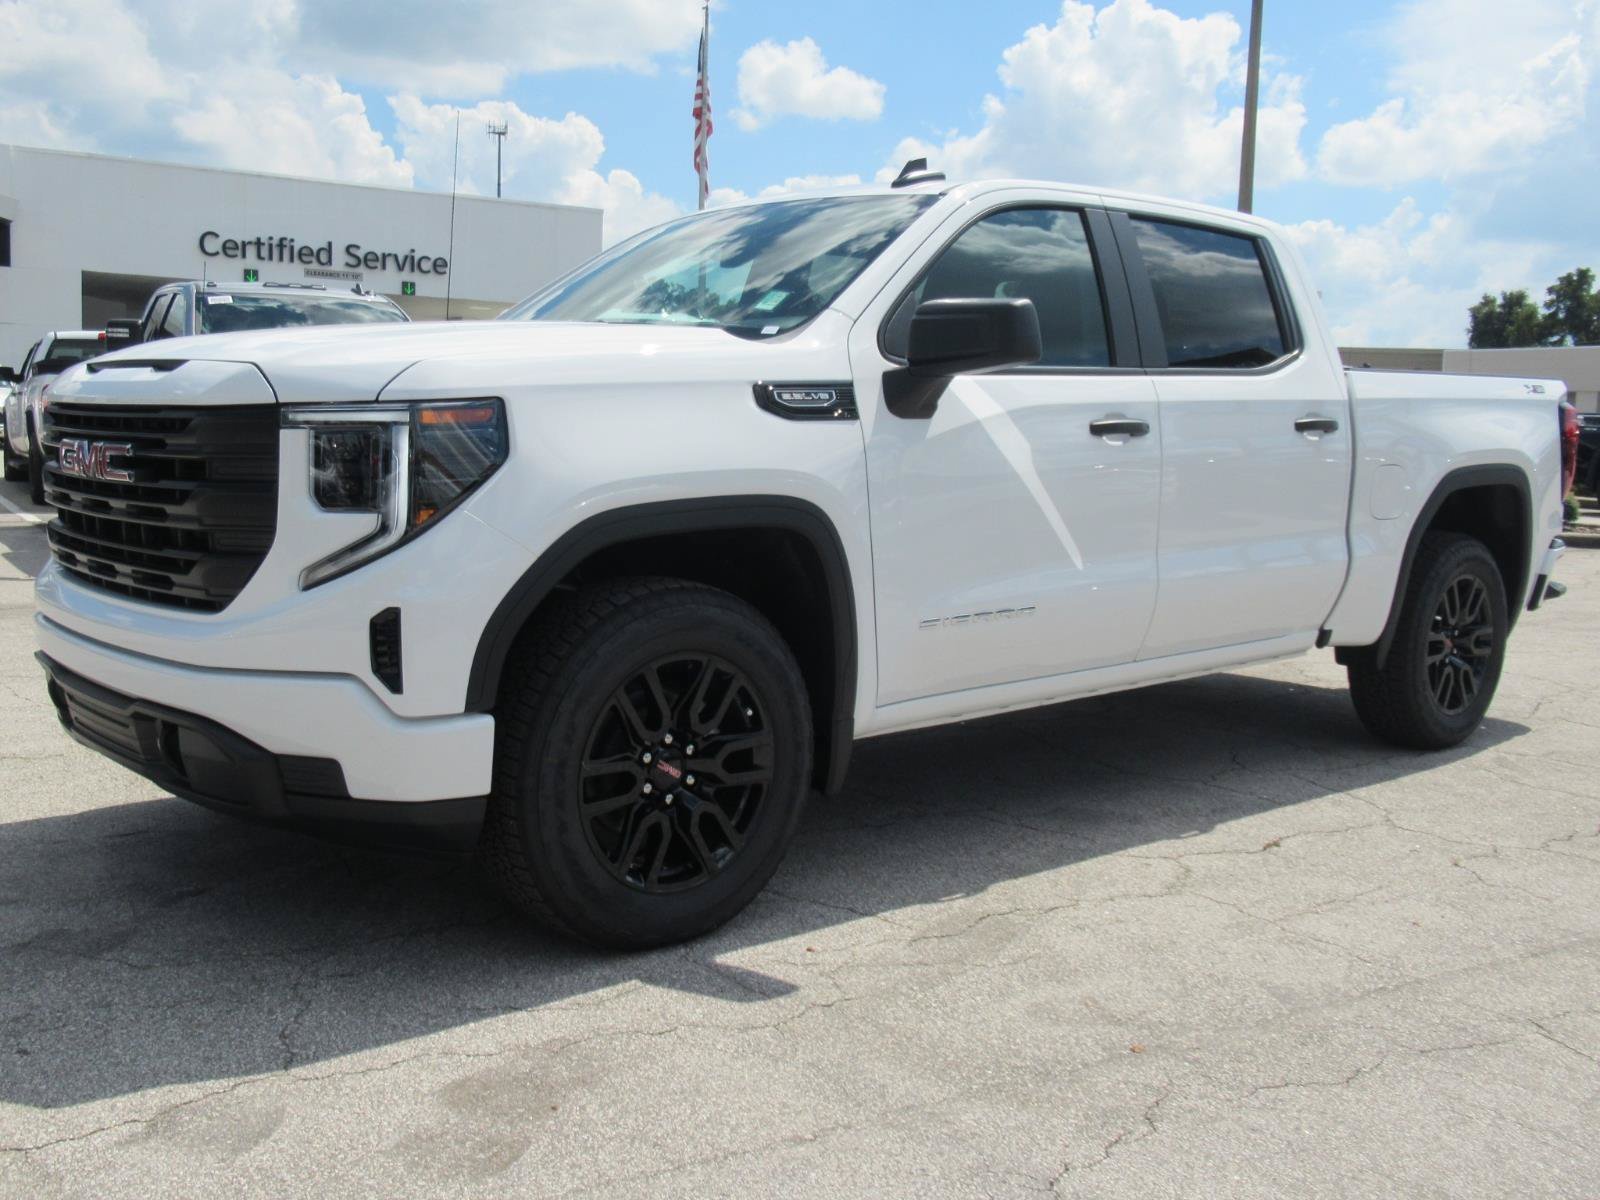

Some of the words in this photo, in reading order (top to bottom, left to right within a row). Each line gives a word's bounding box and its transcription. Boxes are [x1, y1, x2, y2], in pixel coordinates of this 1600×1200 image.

[199, 231, 333, 266] Certified
[344, 244, 448, 275] Service
[60, 438, 134, 482] GMC
